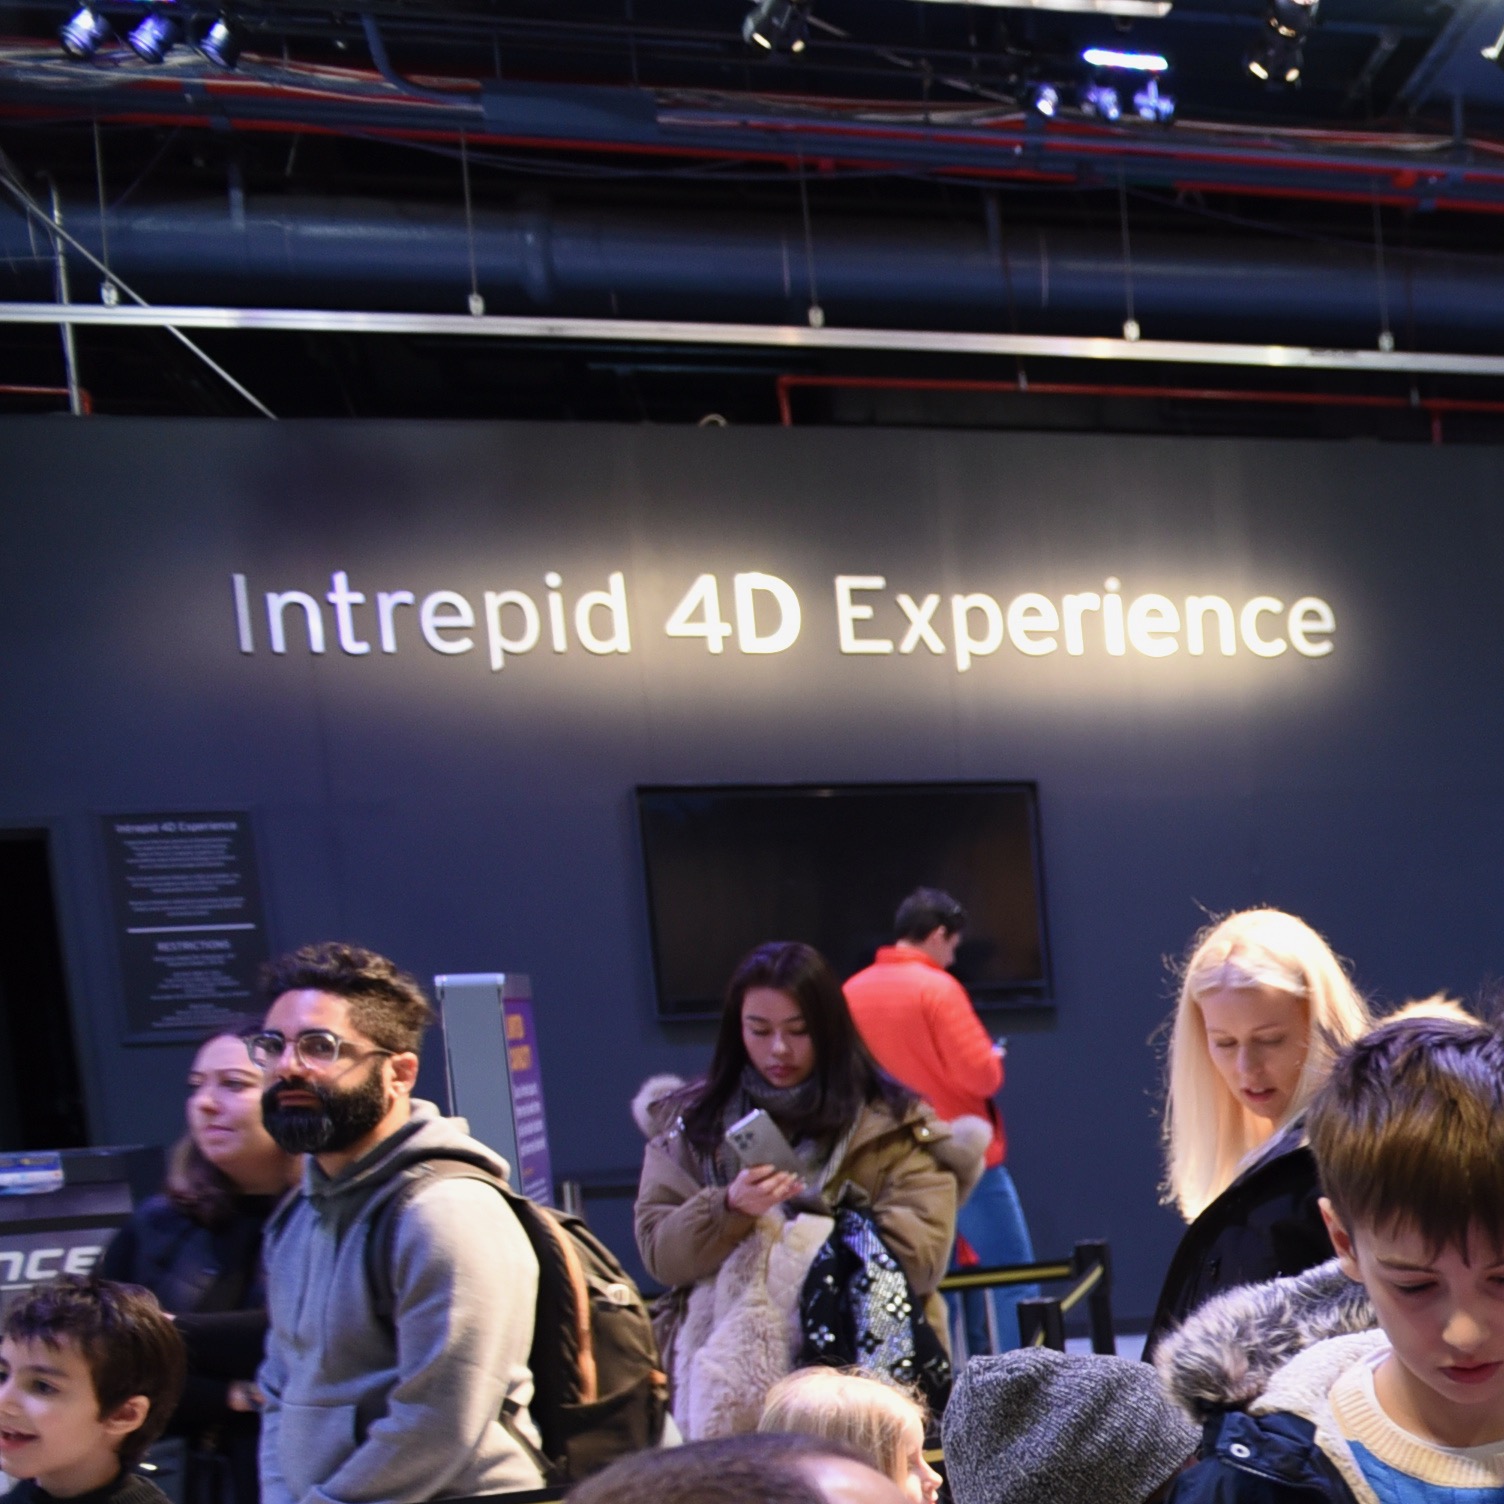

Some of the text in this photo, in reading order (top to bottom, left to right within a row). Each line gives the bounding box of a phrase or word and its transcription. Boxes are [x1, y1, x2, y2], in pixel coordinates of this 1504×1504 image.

[232, 570, 1337, 672] Intrepid 4D Experience
